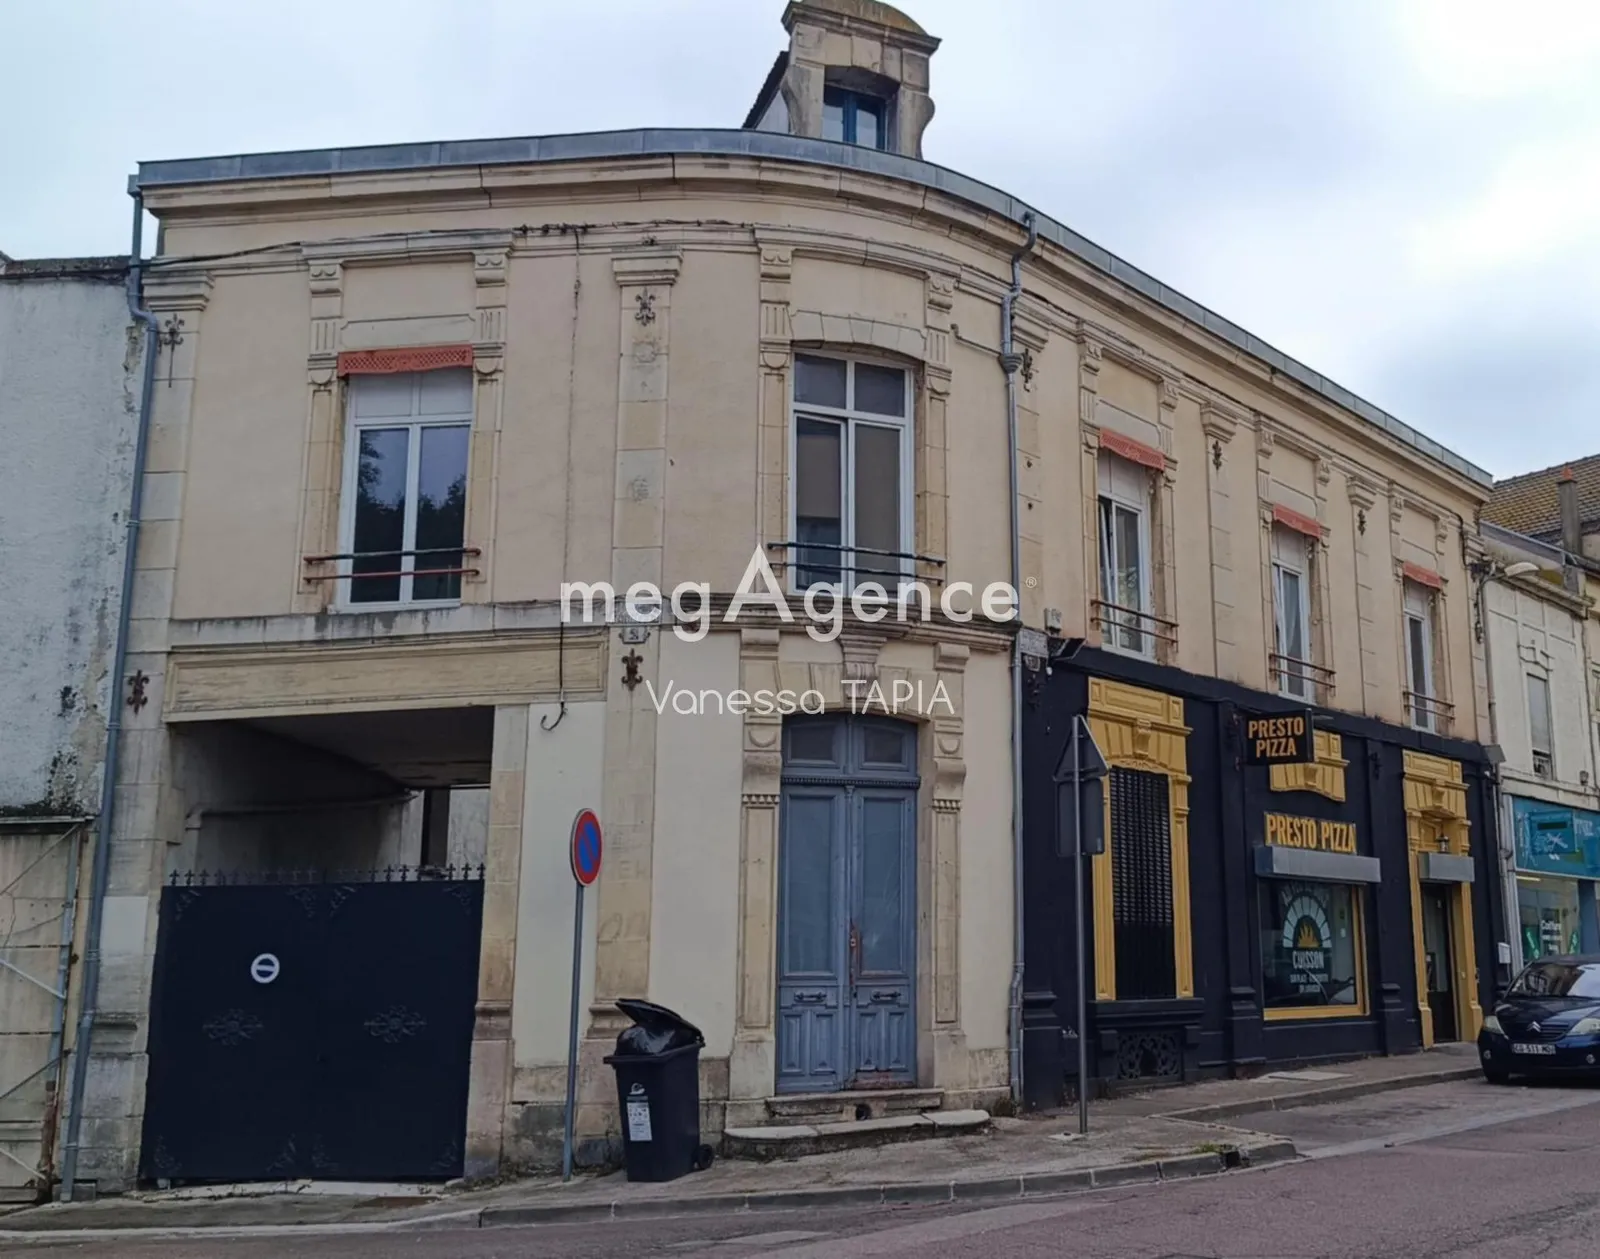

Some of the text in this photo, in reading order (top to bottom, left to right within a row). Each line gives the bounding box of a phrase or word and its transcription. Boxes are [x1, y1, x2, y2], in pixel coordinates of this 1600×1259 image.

[1248, 717, 1304, 738] PRESTO
[1256, 738, 1297, 758] PIZZA
[1265, 813, 1357, 854] PRESTO PIZZA
